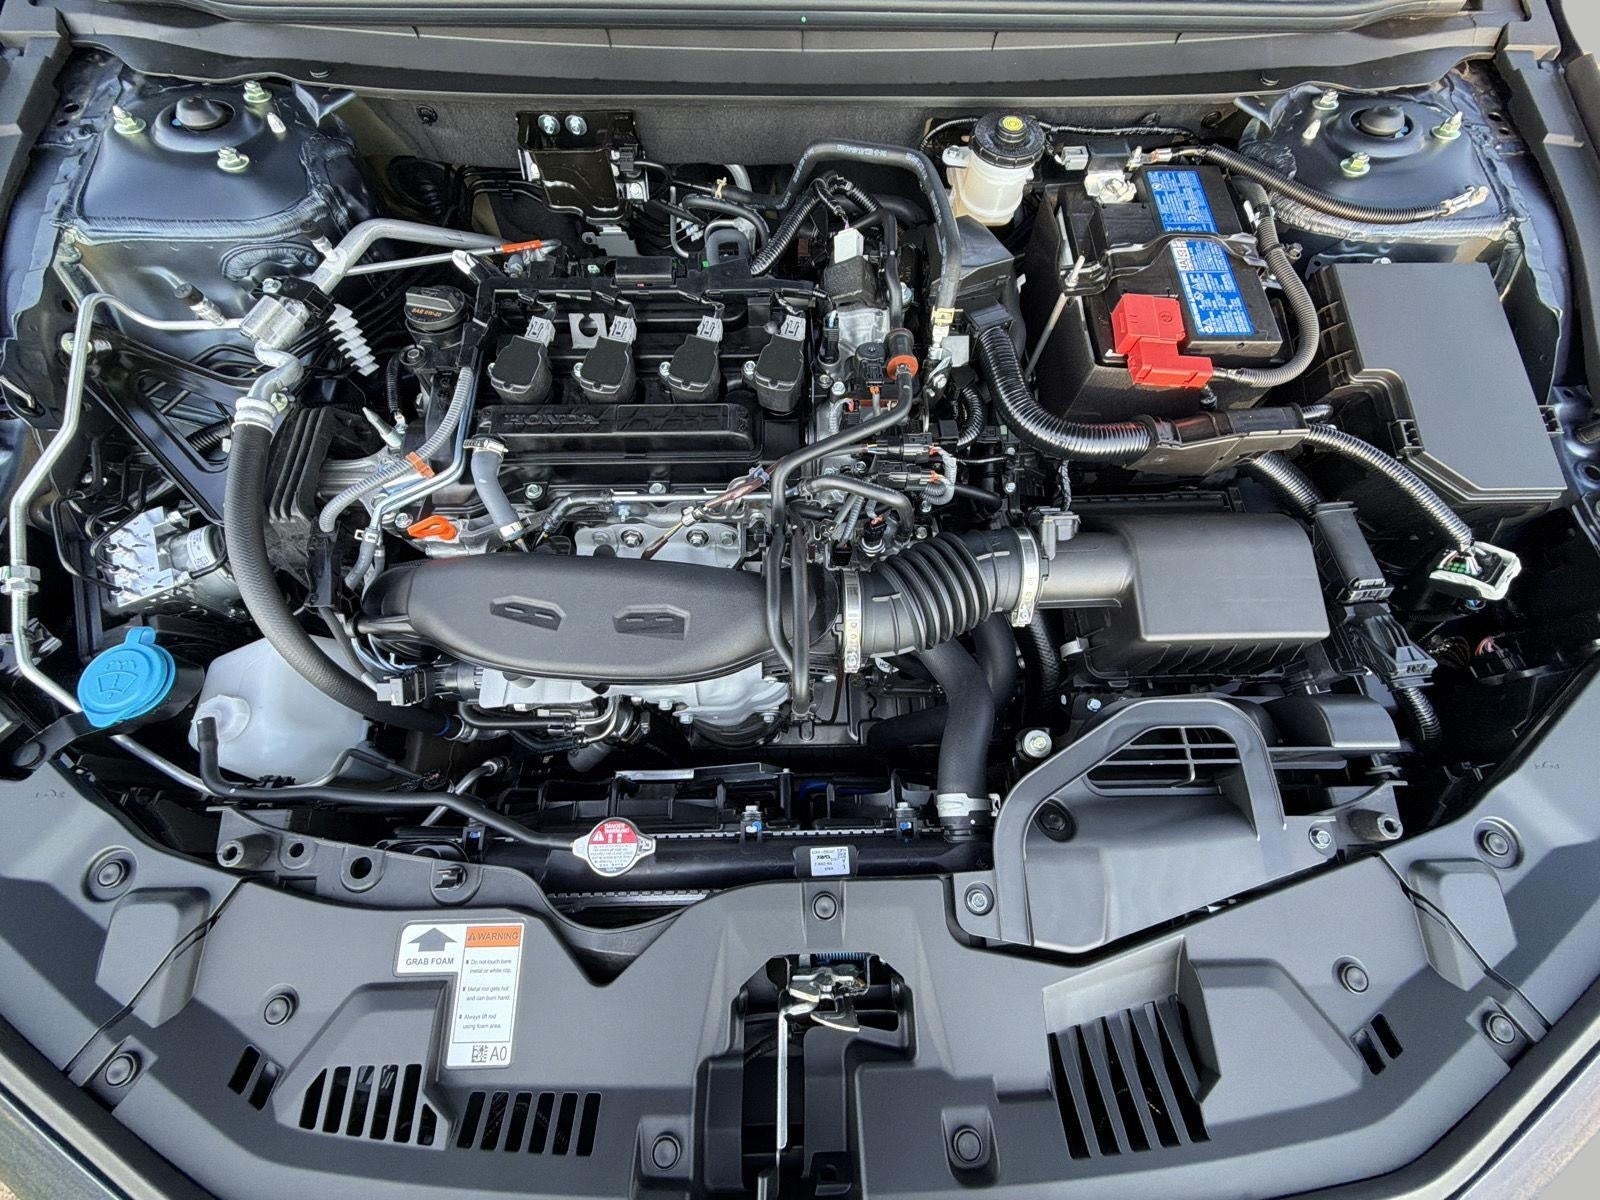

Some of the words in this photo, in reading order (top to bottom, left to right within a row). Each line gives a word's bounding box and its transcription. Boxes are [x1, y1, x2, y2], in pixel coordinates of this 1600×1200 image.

[503, 413, 600, 426] HONDA
[477, 931, 519, 941] WARNING
[405, 957, 429, 966] GRAB
[430, 957, 454, 966] FOAM
[489, 1045, 508, 1062] A0
